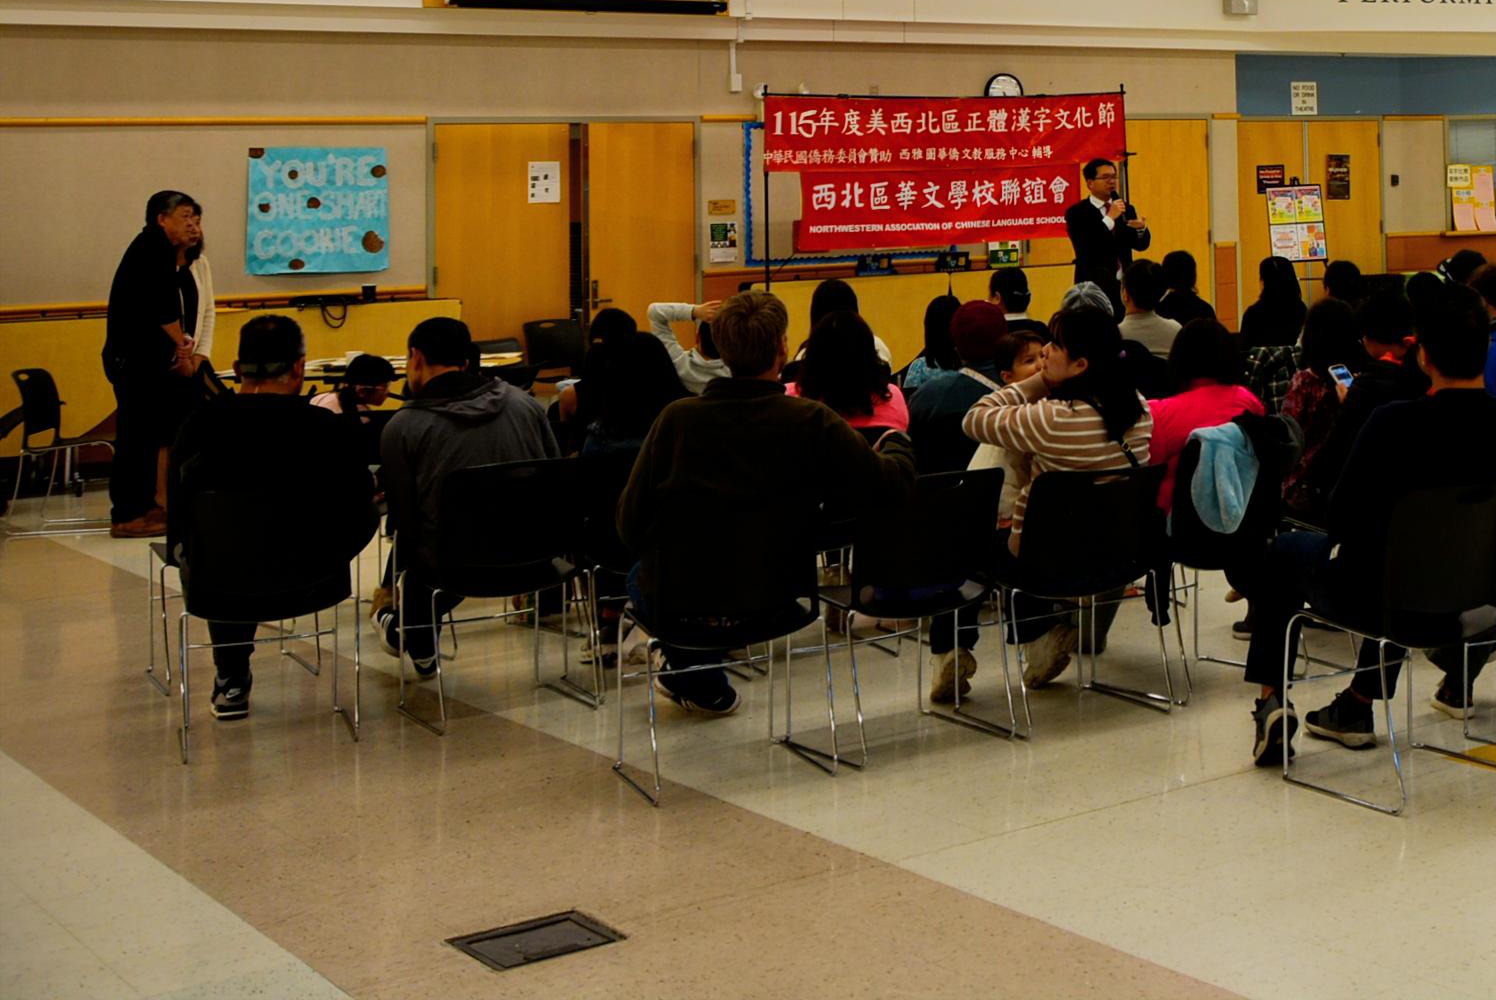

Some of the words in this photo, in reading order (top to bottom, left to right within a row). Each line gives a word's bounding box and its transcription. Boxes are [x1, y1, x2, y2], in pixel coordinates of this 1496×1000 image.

[771, 102, 1116, 137] 115年度美西北區正體漢字文化節
[259, 153, 378, 188] YOU'RE
[254, 189, 313, 222] ONE
[319, 188, 389, 221] SMART
[811, 175, 1071, 212] 西北區華文學校聯誼會
[253, 225, 358, 260] COOKIE
[809, 222, 884, 235] NORTHWESTERN
[884, 220, 940, 233] ASSOCIATION
[941, 220, 953, 231] OF
[955, 218, 991, 230] CHINESE
[991, 216, 1035, 228] LANGUAGE
